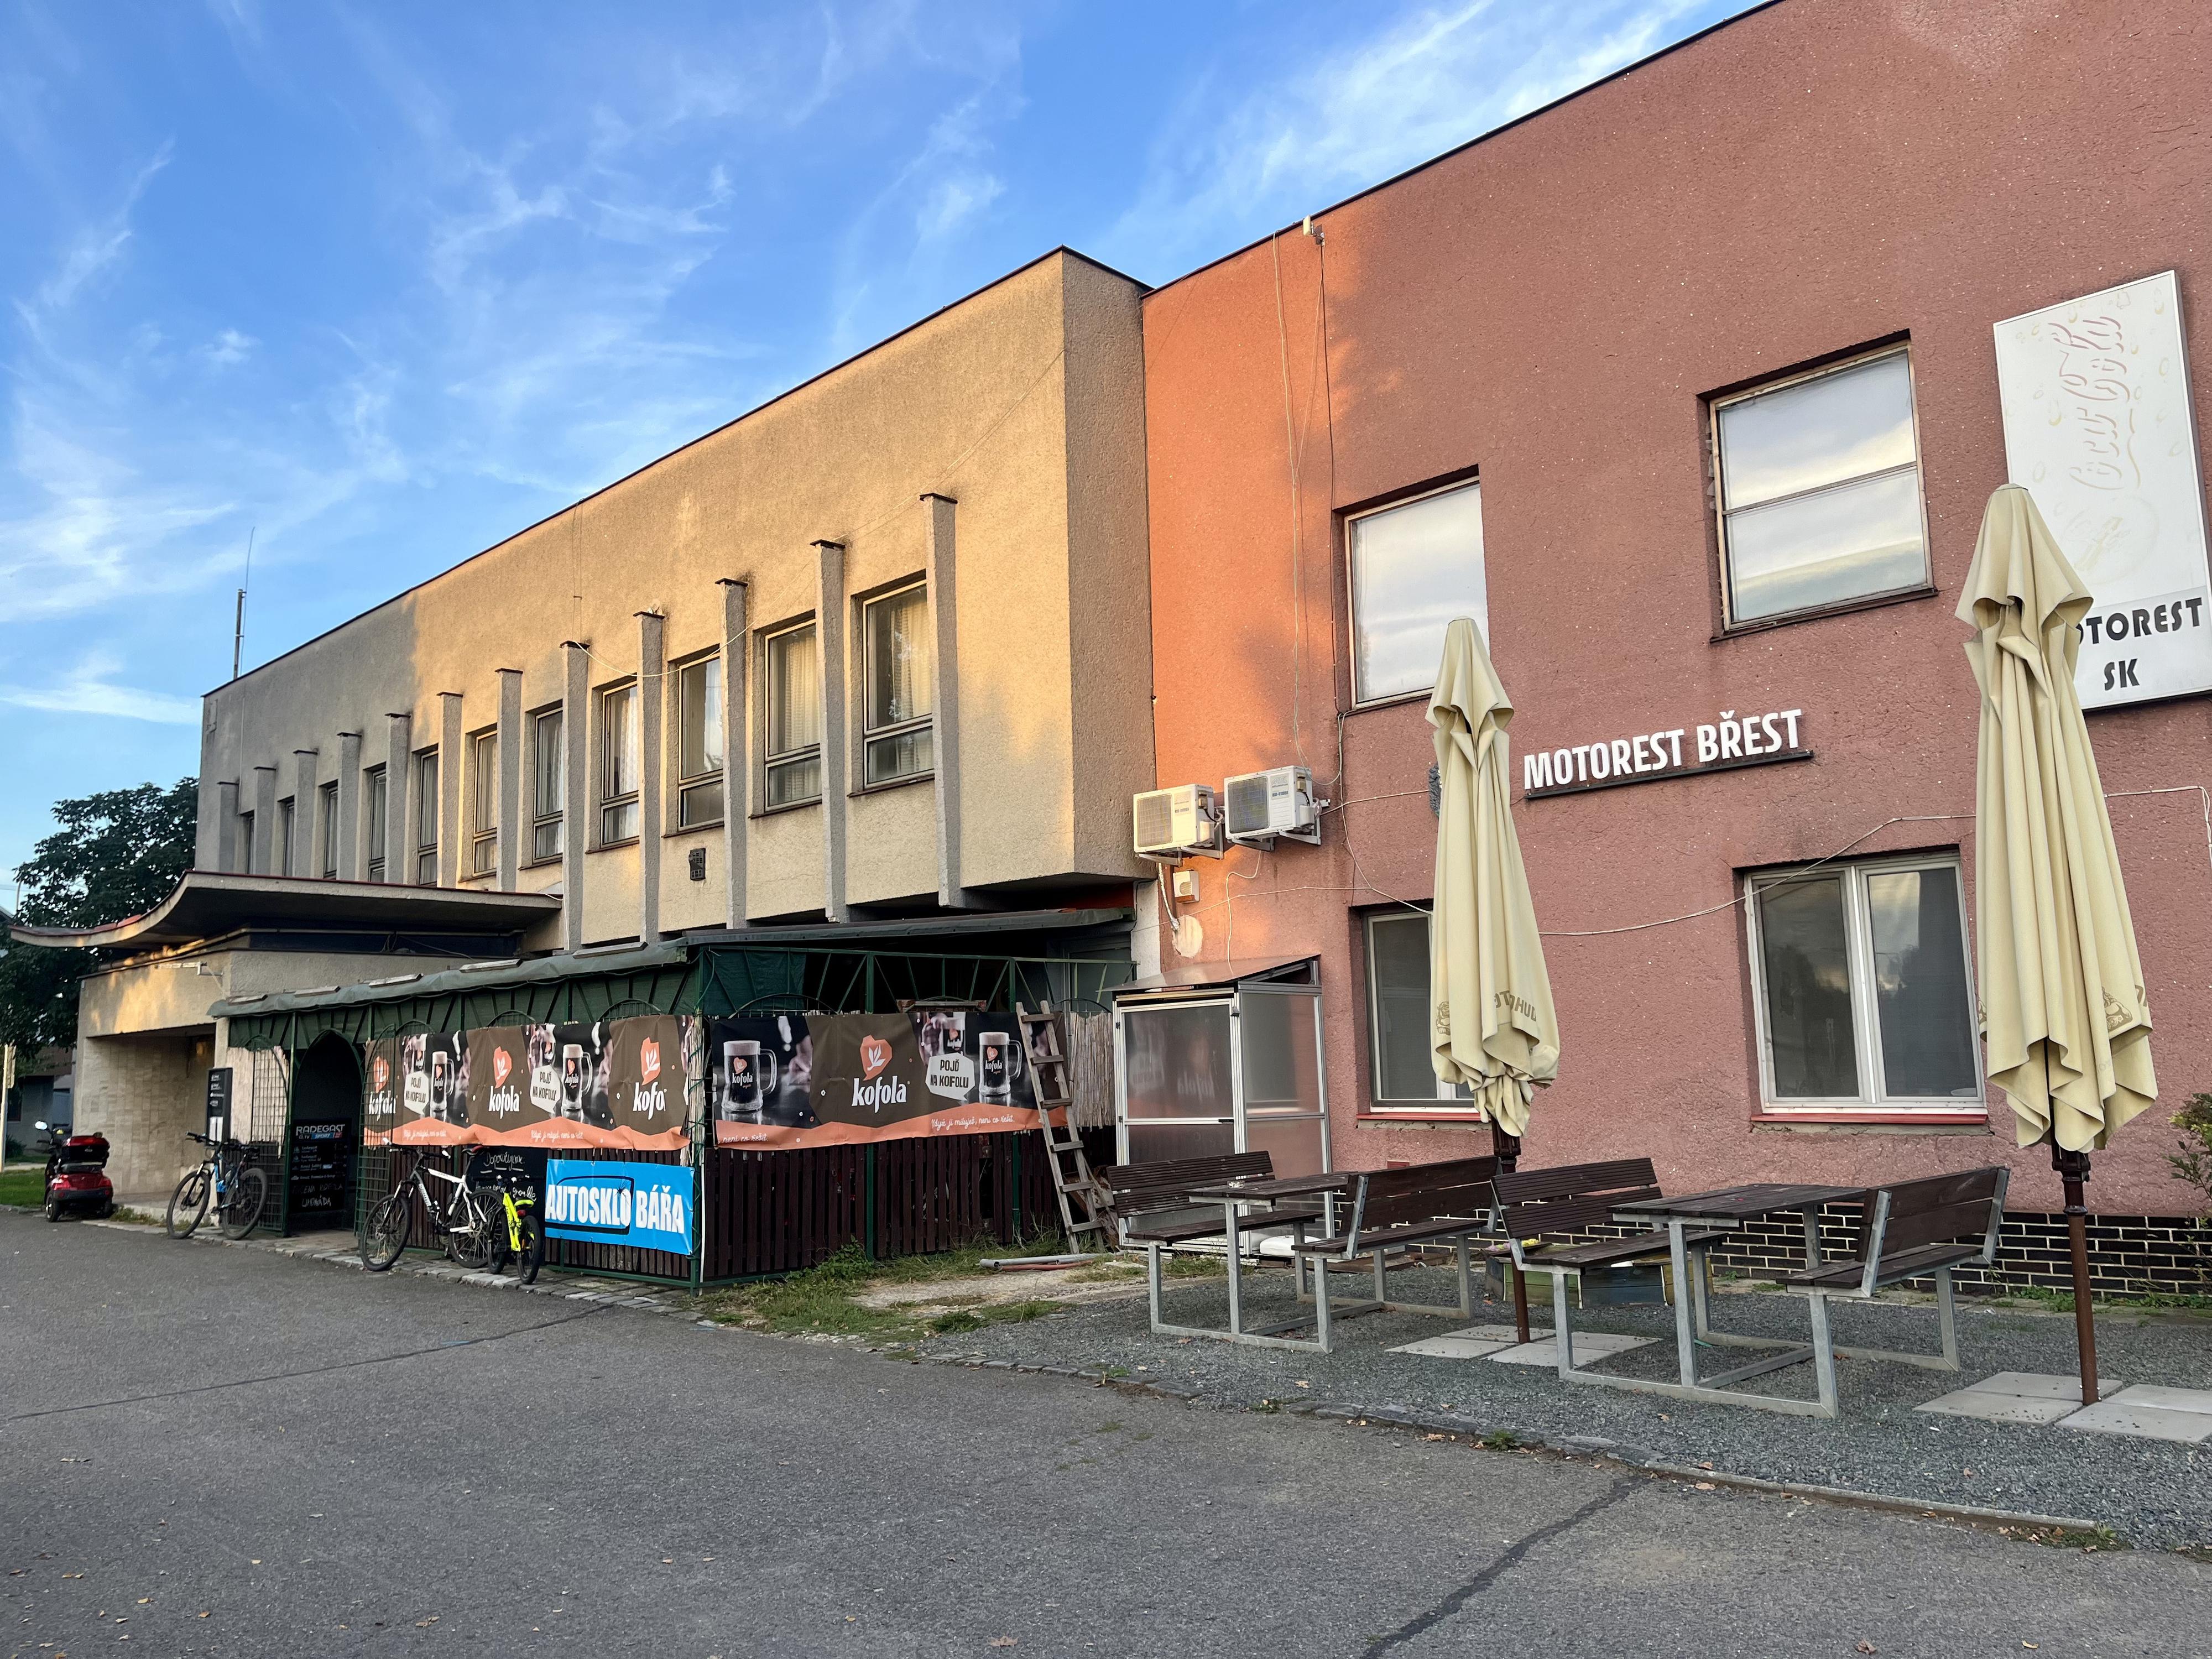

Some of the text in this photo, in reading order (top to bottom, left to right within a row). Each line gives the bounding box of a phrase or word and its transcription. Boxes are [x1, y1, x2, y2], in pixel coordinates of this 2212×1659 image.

[2075, 597, 2203, 644] TOREST
[2104, 659, 2140, 691] SK
[1524, 708, 1802, 790] MOTOREST BŘEST
[732, 1072, 753, 1086] kofola
[930, 1074, 969, 1088] NA KOFOLU
[940, 1059, 959, 1072] POJĎ
[985, 1060, 1003, 1072] kofola
[488, 1086, 520, 1119] kofola
[852, 1076, 906, 1113] kofola
[296, 1124, 345, 1136] RADEGAST
[545, 1184, 684, 1234] AUTOSKLO BÁŘA
